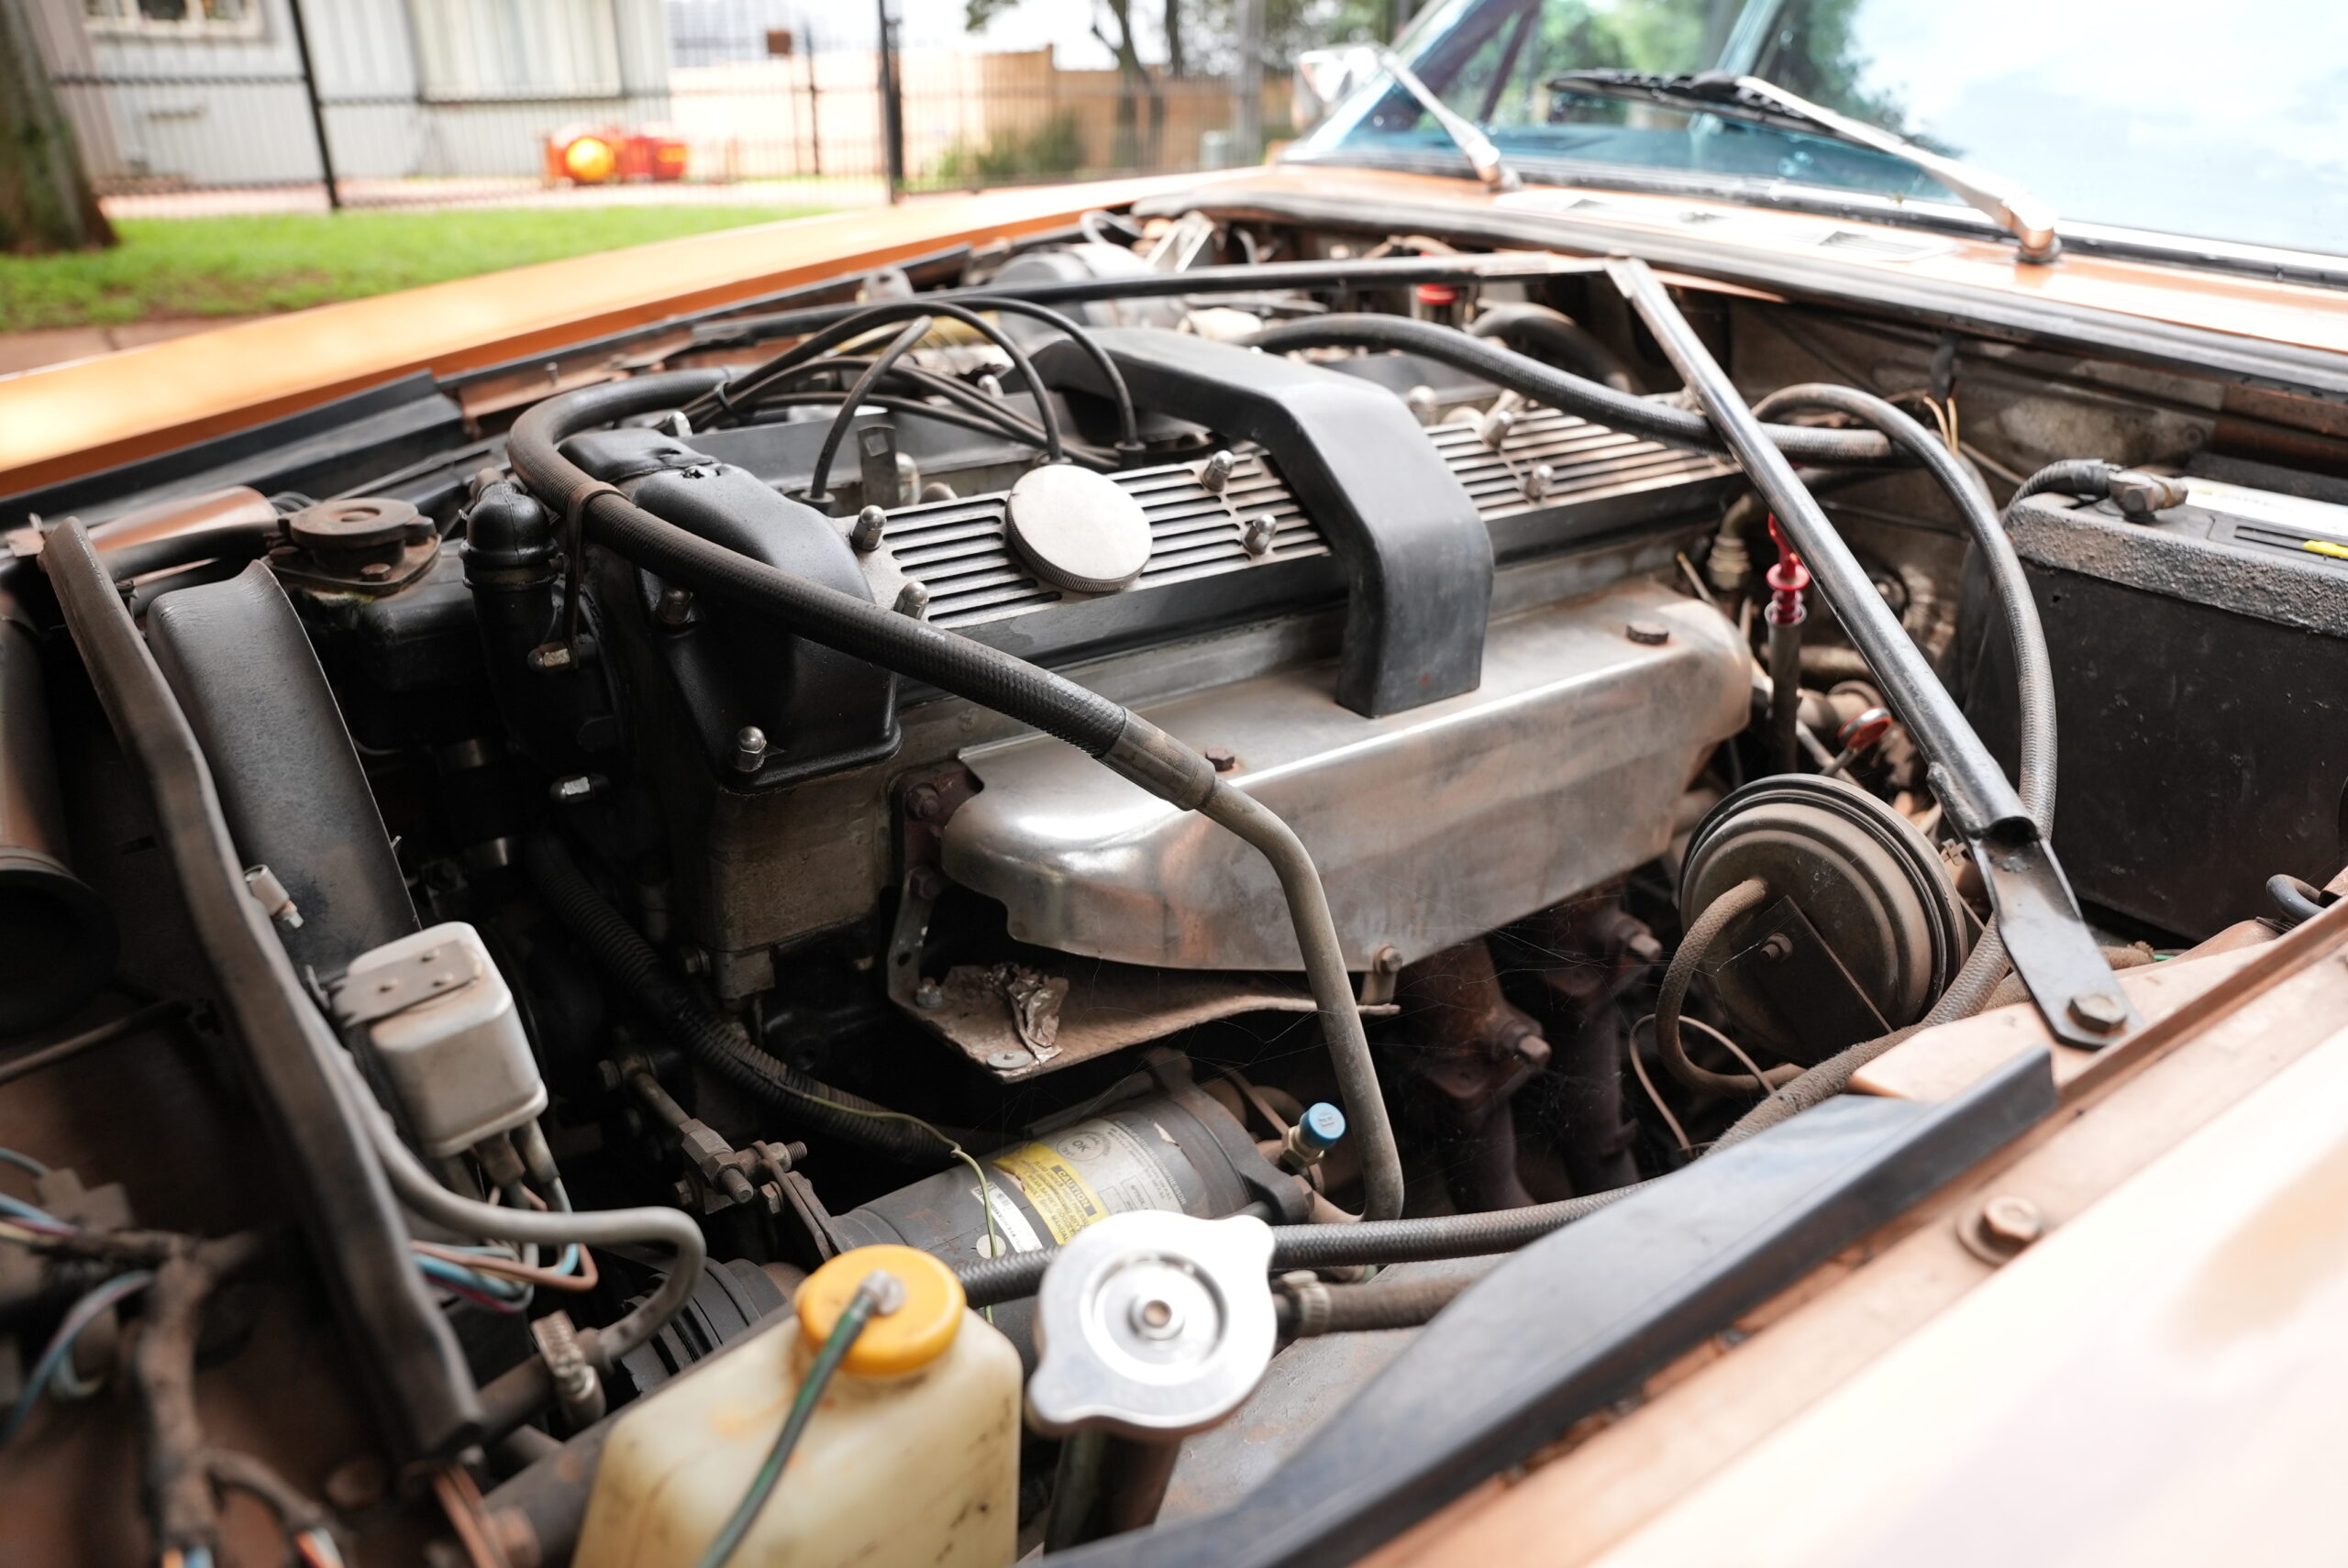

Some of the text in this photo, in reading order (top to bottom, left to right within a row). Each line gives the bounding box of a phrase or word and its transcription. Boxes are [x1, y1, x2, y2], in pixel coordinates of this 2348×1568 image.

[1072, 1140, 1089, 1153] OK
[1057, 1169, 1091, 1208] CAUTION
[1157, 1159, 1187, 1205] COMPRESSOR
